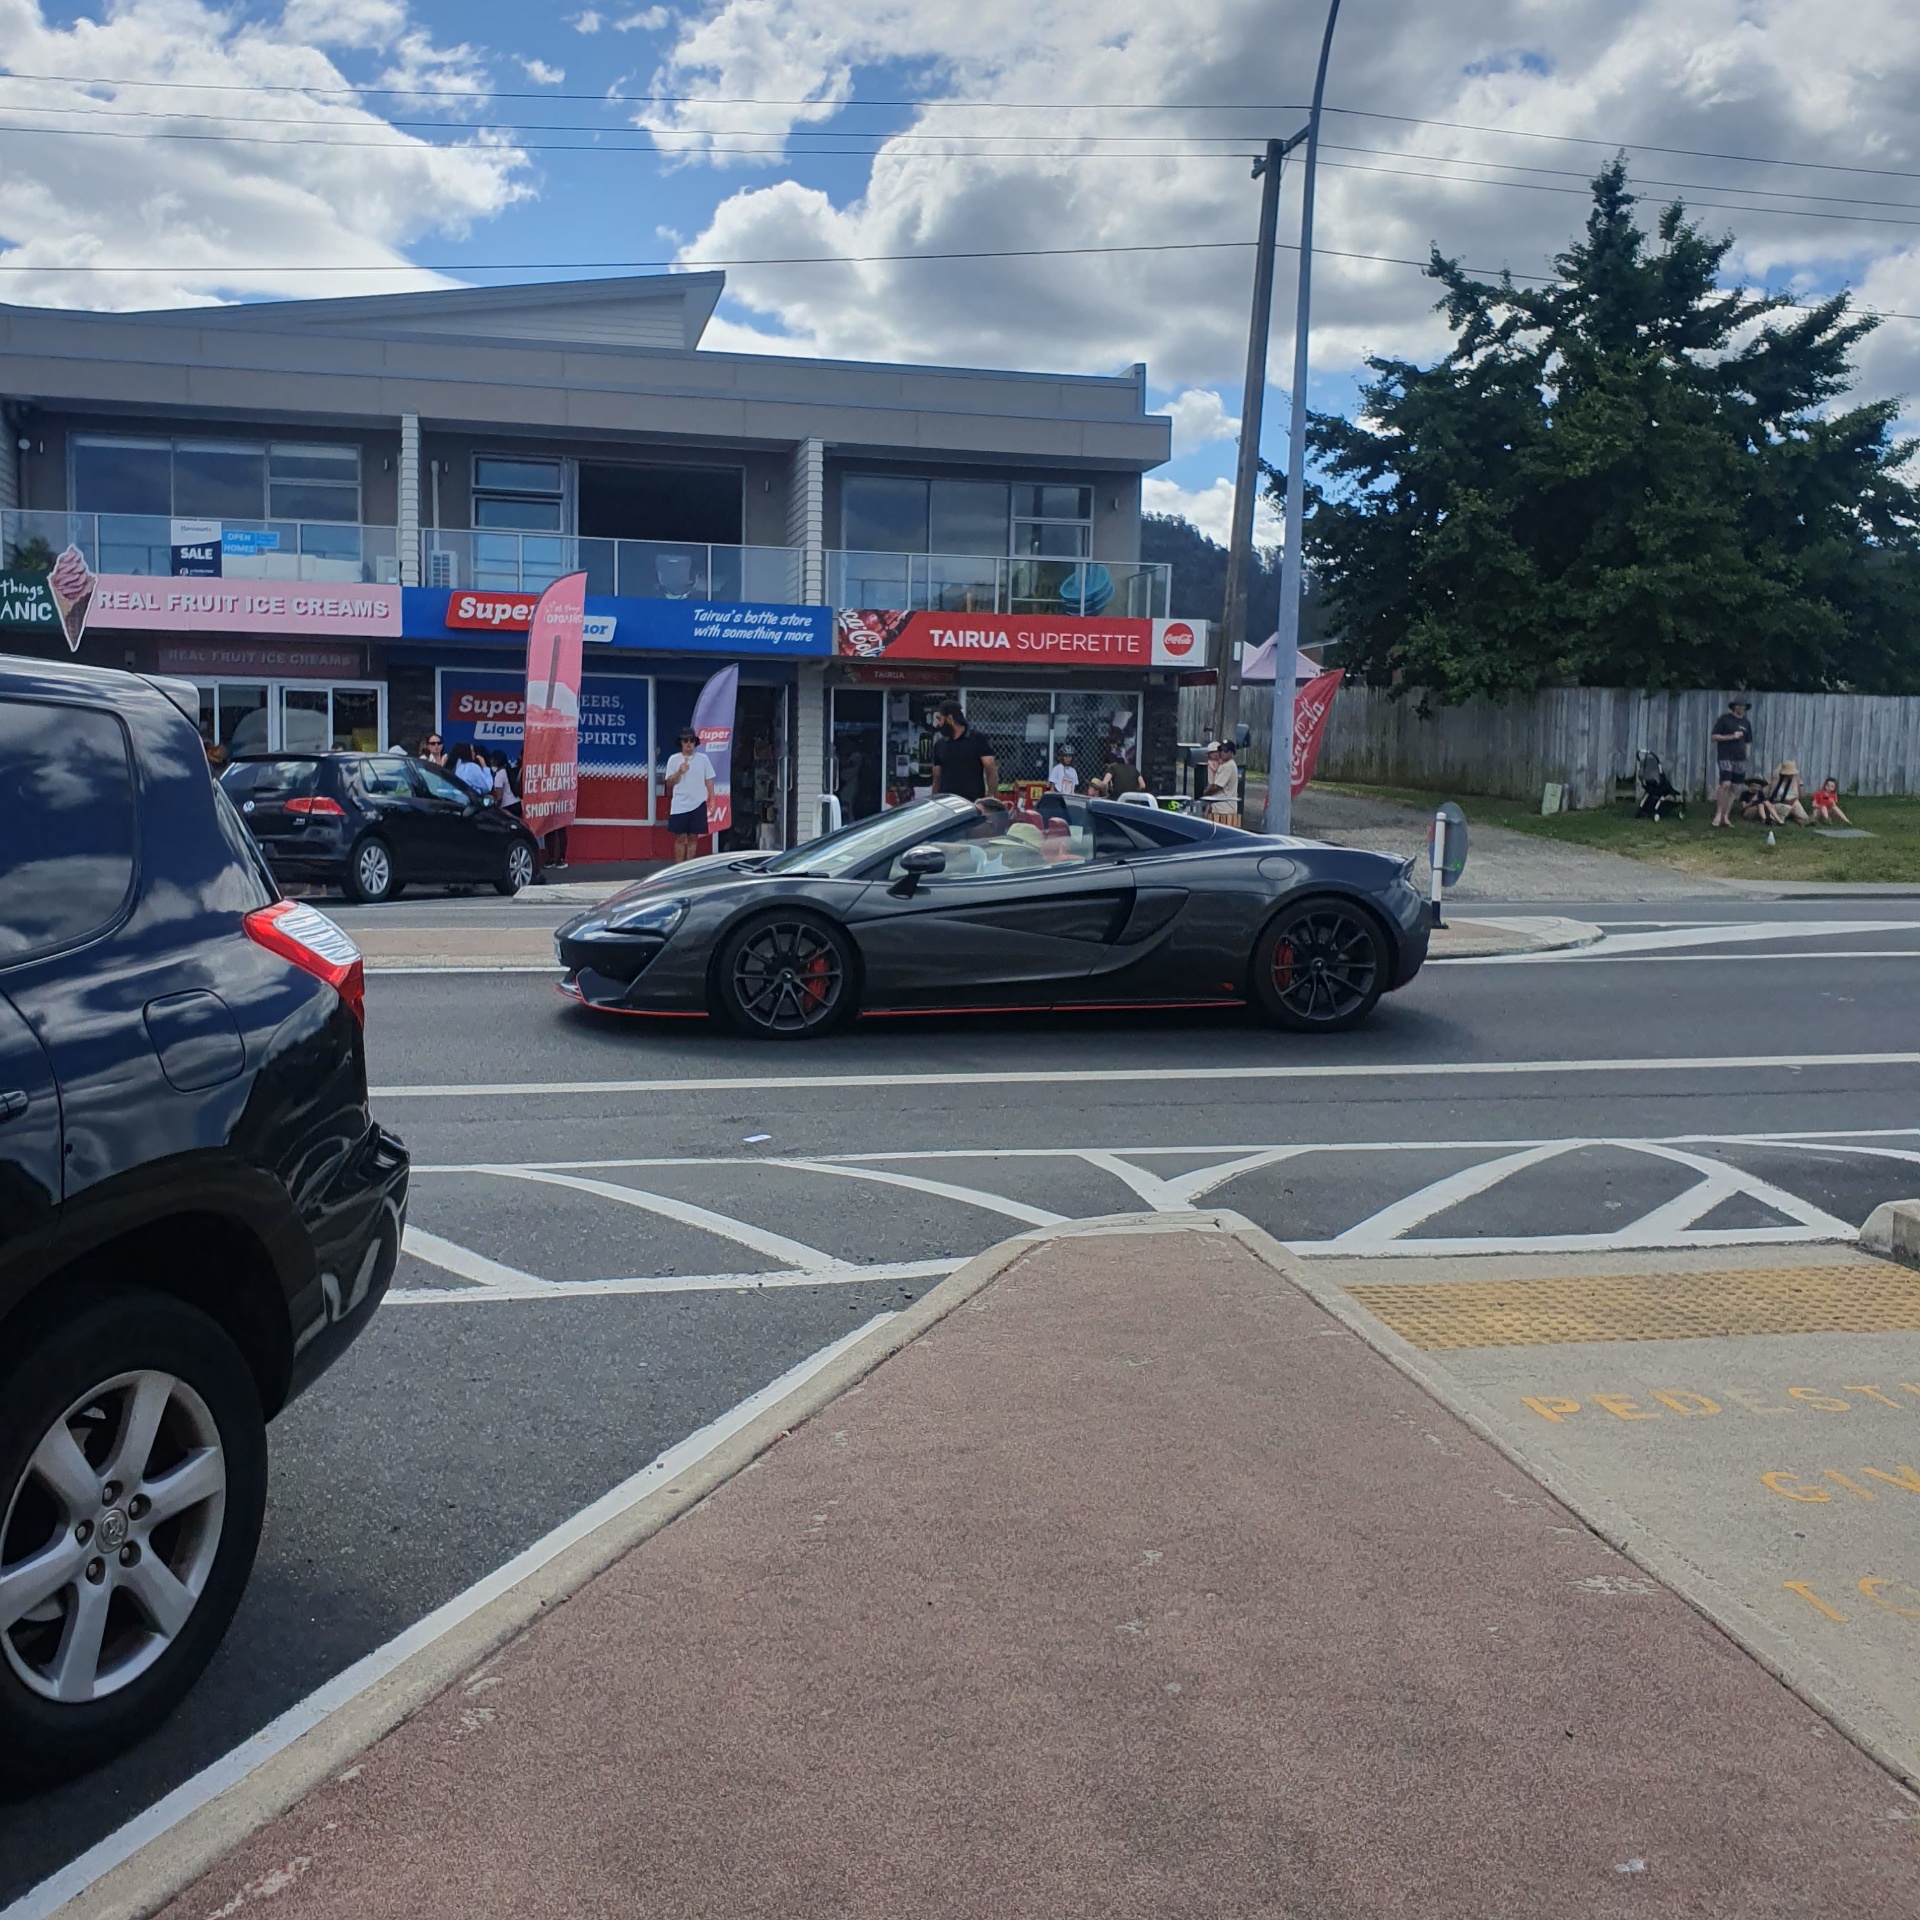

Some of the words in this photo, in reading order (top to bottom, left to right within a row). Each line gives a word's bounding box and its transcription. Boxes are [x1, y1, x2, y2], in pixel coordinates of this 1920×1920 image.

[227, 532, 251, 541] OPEN
[180, 548, 213, 560] SALE
[223, 544, 255, 553] HOMES
[0, 577, 44, 601] things
[0, 600, 52, 621] ANIC
[96, 590, 161, 611] REAL
[166, 593, 239, 613] FRUIT
[245, 595, 285, 615] ICE
[291, 597, 390, 619] CREAMS
[694, 609, 743, 623] Tairua's
[744, 610, 778, 624] bottle
[780, 613, 813, 627] store
[694, 624, 721, 638] with
[721, 626, 783, 645] something
[783, 632, 814, 642] more
[930, 629, 1010, 649] TAIRUA
[1016, 631, 1141, 653] SUPERETTE
[262, 652, 285, 664] ICE
[579, 695, 625, 709] EERS,
[482, 722, 524, 737] Liquo
[699, 730, 730, 741] Super
[577, 732, 637, 746] SPIRITS
[526, 763, 548, 779] REAL
[550, 761, 576, 777] FRUIT
[525, 778, 538, 794] ICE
[540, 776, 577, 793] CREAMS
[525, 799, 576, 819] SMOOTHIES
[1521, 1382, 1920, 1423] PEDEST
